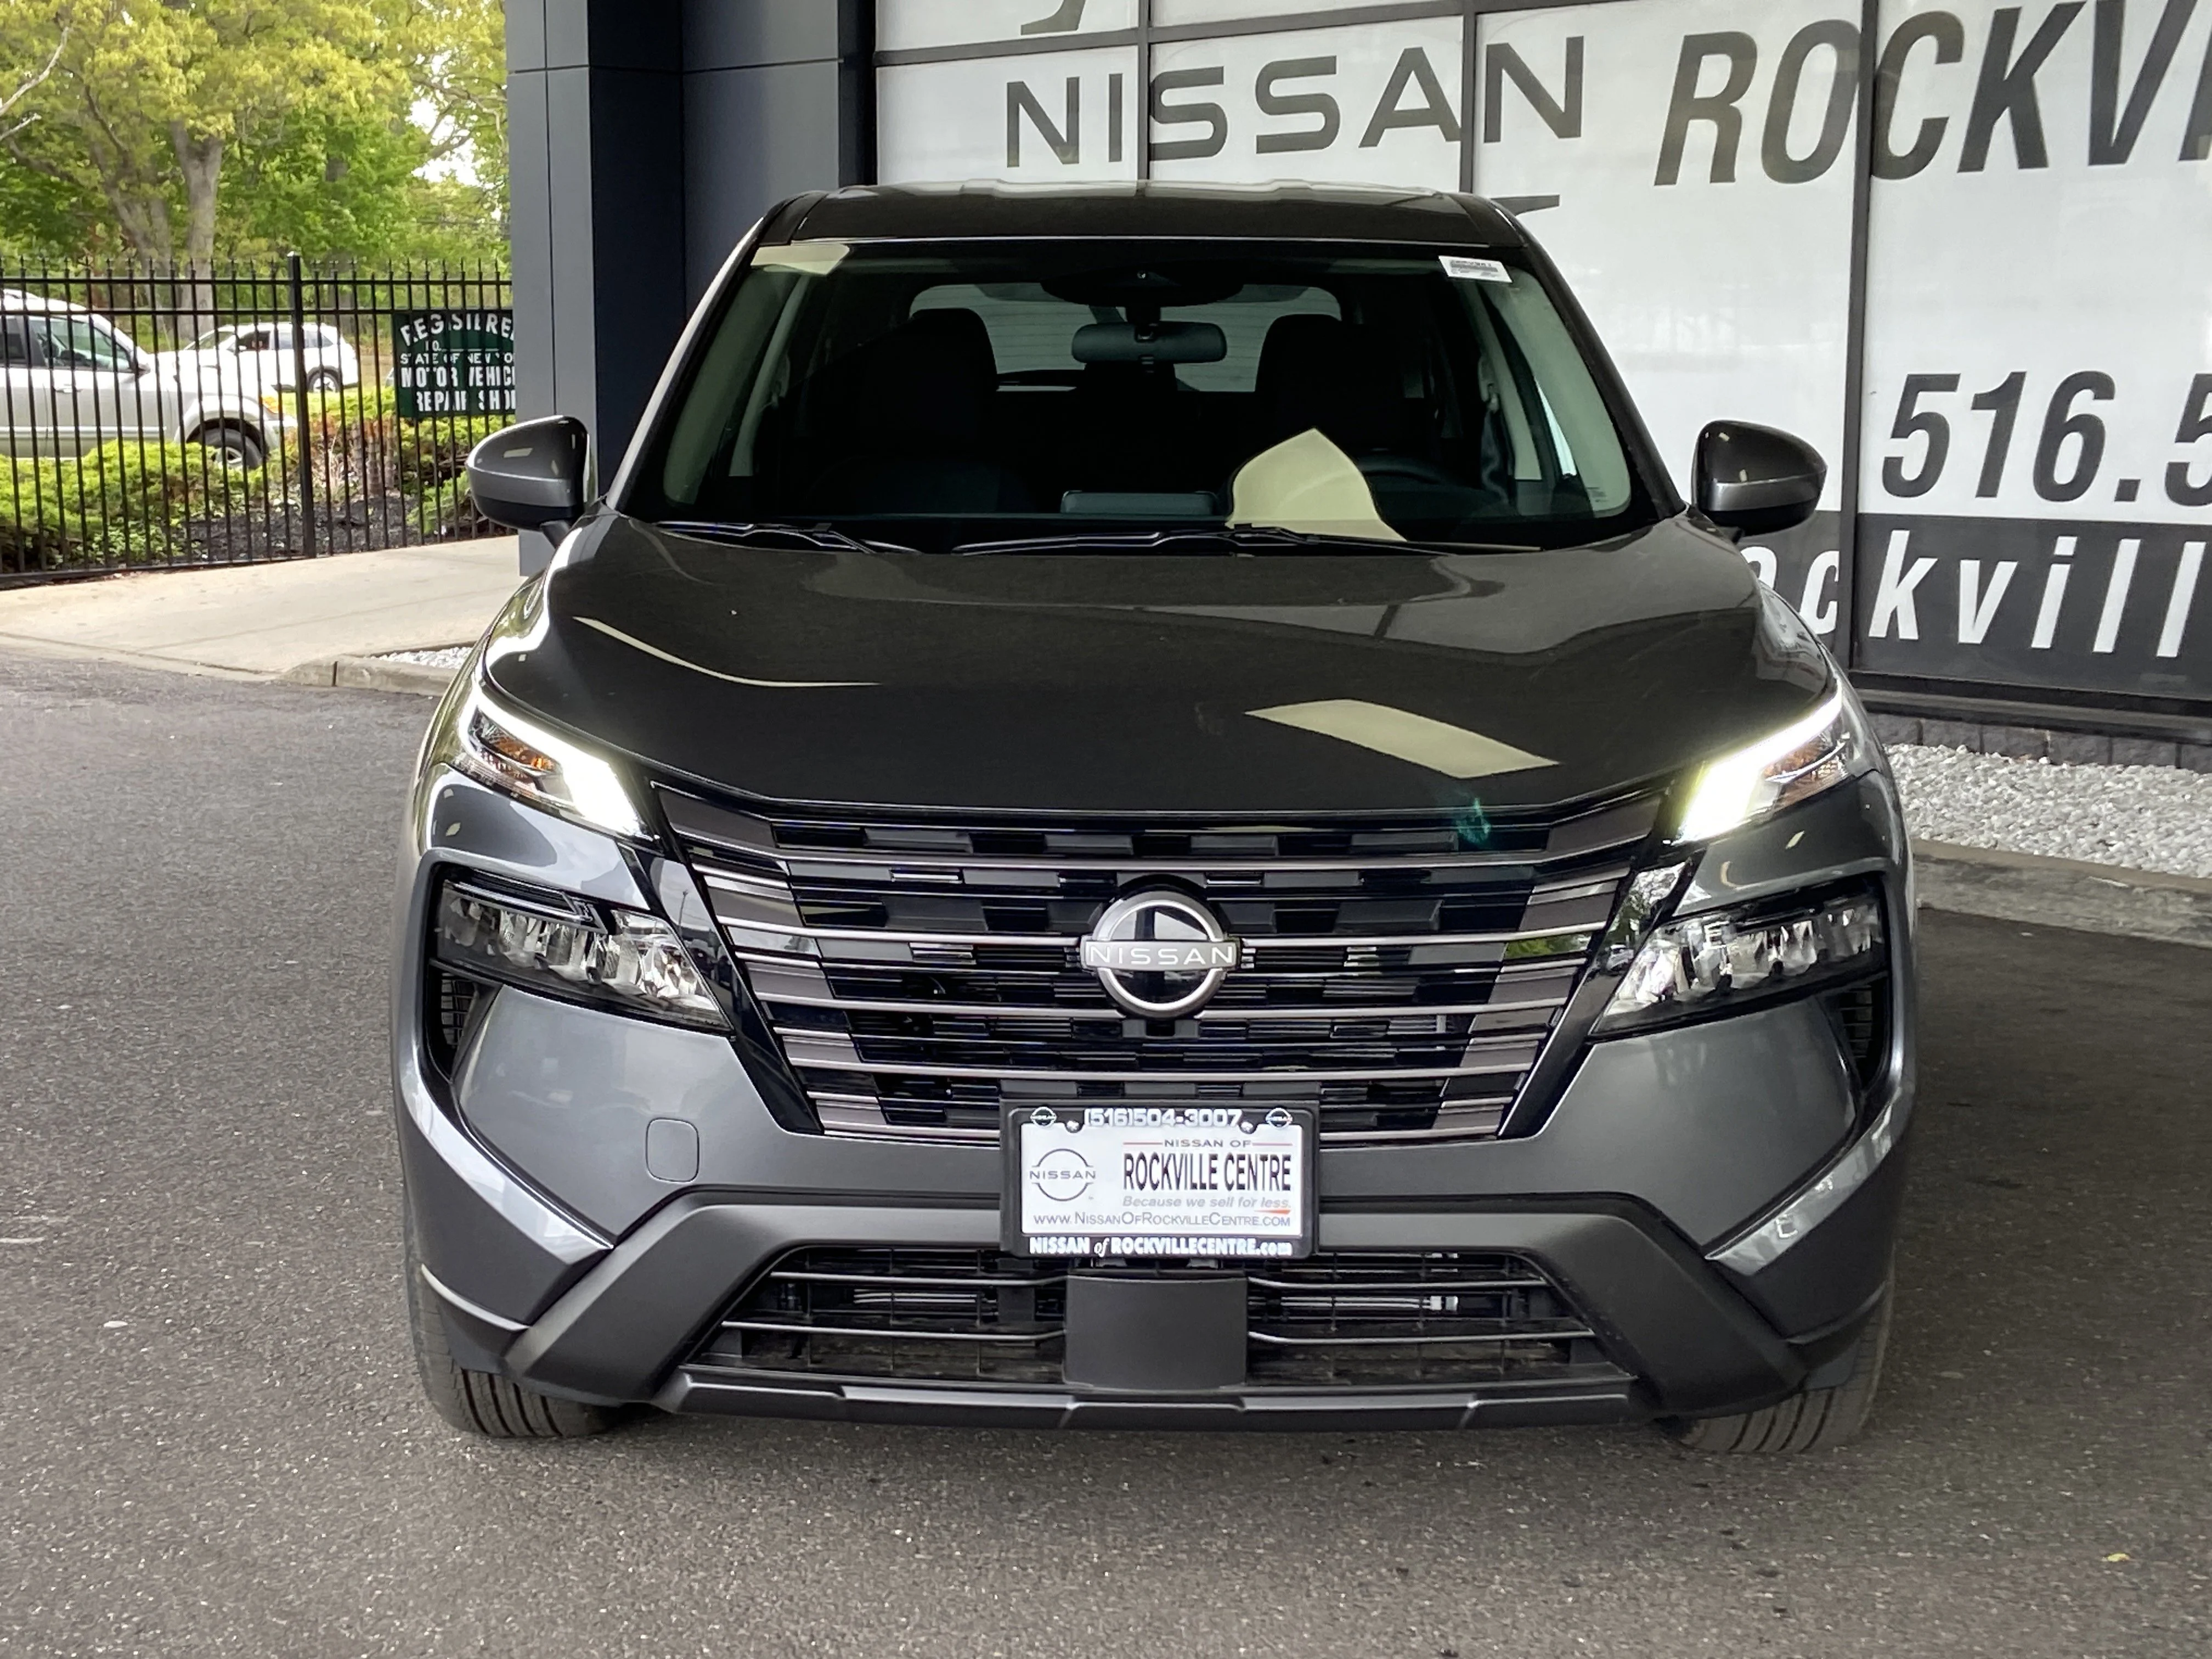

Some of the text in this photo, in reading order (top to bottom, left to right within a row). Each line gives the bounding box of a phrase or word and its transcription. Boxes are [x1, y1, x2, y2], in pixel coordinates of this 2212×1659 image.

[1006, 36, 1584, 168] NISSAN
[1090, 946, 1233, 966] NISSAN
[1164, 1139, 1252, 1148] NISSAN OF
[1029, 1170, 1097, 1180] NISSAN
[1123, 1153, 1291, 1192] ROCKVILLE CENTRE
[1122, 1196, 1291, 1209] Because we sell for less.
[1029, 1237, 1293, 1257] NISSAN of ROCKVILLECENTRE.com
